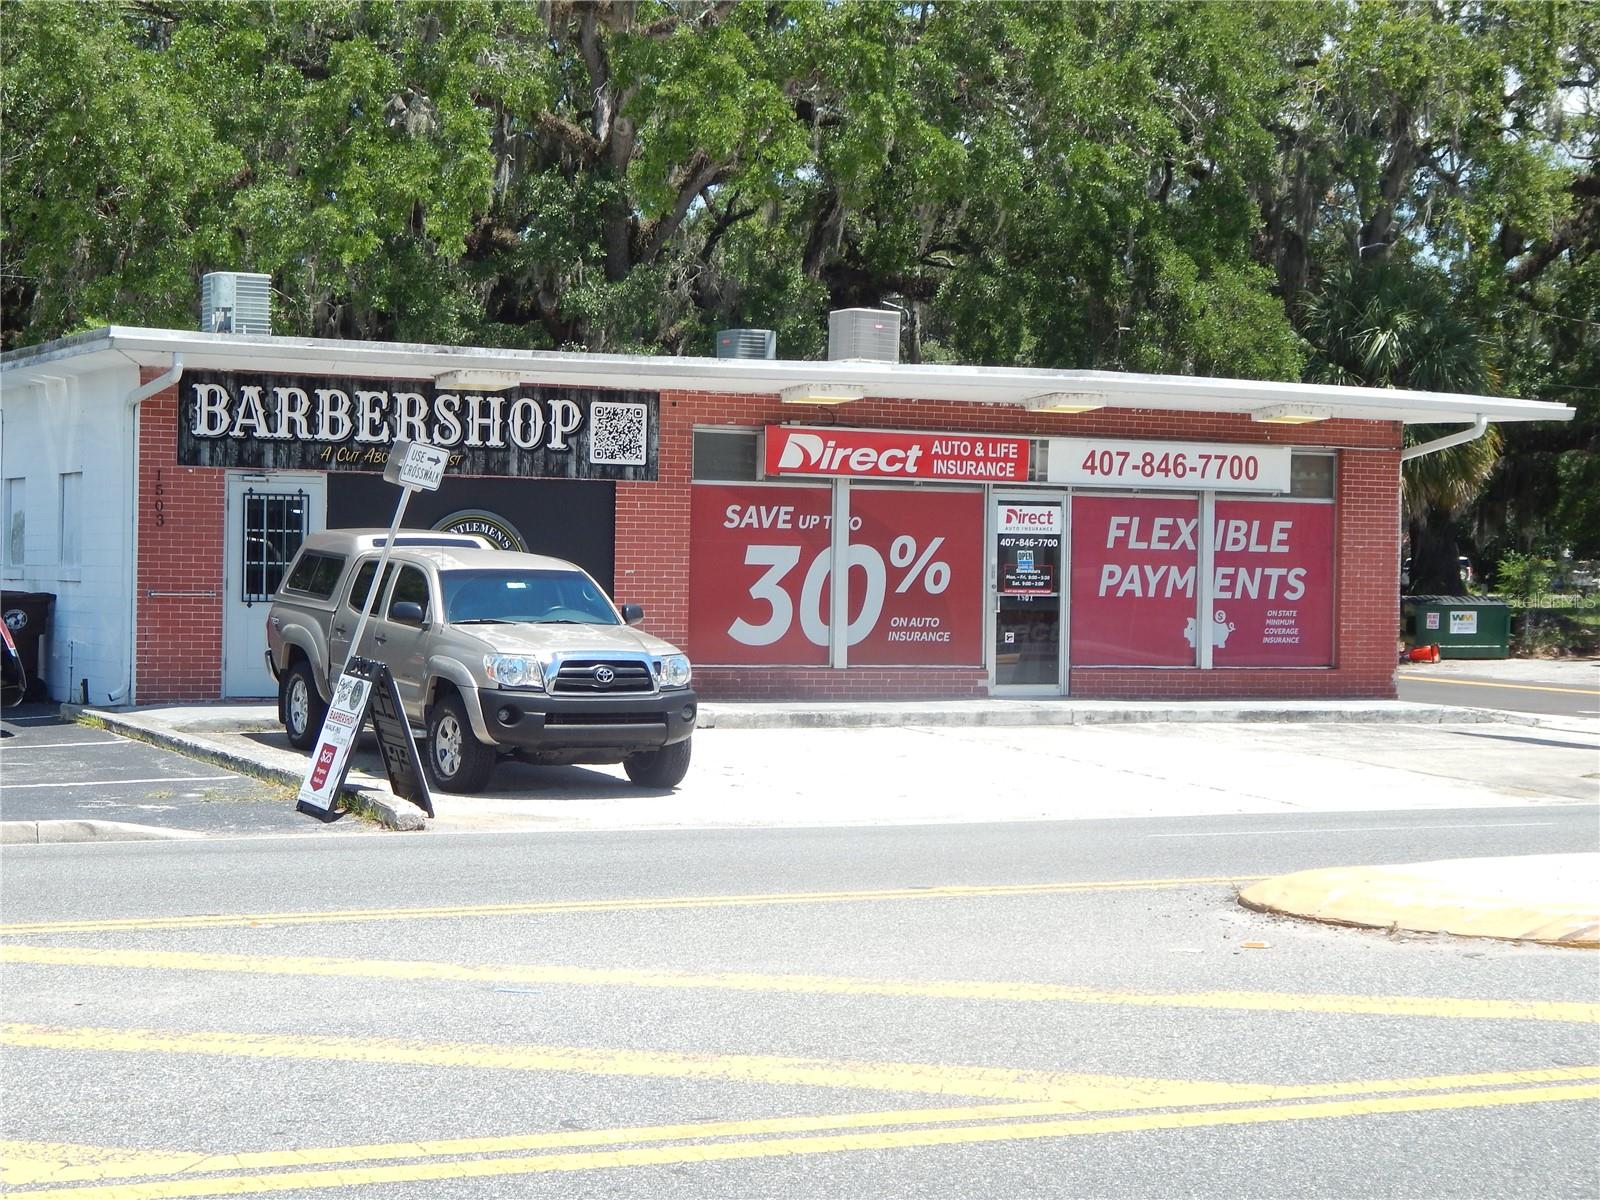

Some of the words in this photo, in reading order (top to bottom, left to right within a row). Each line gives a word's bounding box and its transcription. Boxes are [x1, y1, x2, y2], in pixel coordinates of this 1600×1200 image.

[191, 382, 583, 450] BARBERSHOP
[320, 446, 332, 461] A
[411, 449, 426, 464] USE
[778, 432, 922, 473] Direct
[931, 440, 970, 458] AUTO
[974, 441, 984, 457] &
[988, 442, 1018, 459] LIFE
[401, 463, 441, 484] CROSSWALK
[933, 459, 1015, 477] INSURANCE
[1081, 449, 1259, 481] 407-846-7700
[155, 469, 164, 528] 1503
[723, 504, 795, 529] SAVE
[798, 514, 820, 529] UP
[1005, 508, 1054, 525] Direct
[449, 522, 512, 549] NTLEMEN'S
[1000, 538, 1059, 548] 407-846-7700
[1106, 515, 1293, 553] FLEXIBLE
[727, 535, 951, 647] 30%
[1098, 564, 1307, 601] PAYMENTS
[890, 617, 908, 628] ON
[909, 617, 940, 628] AUTO
[888, 631, 951, 642] INSURANCE
